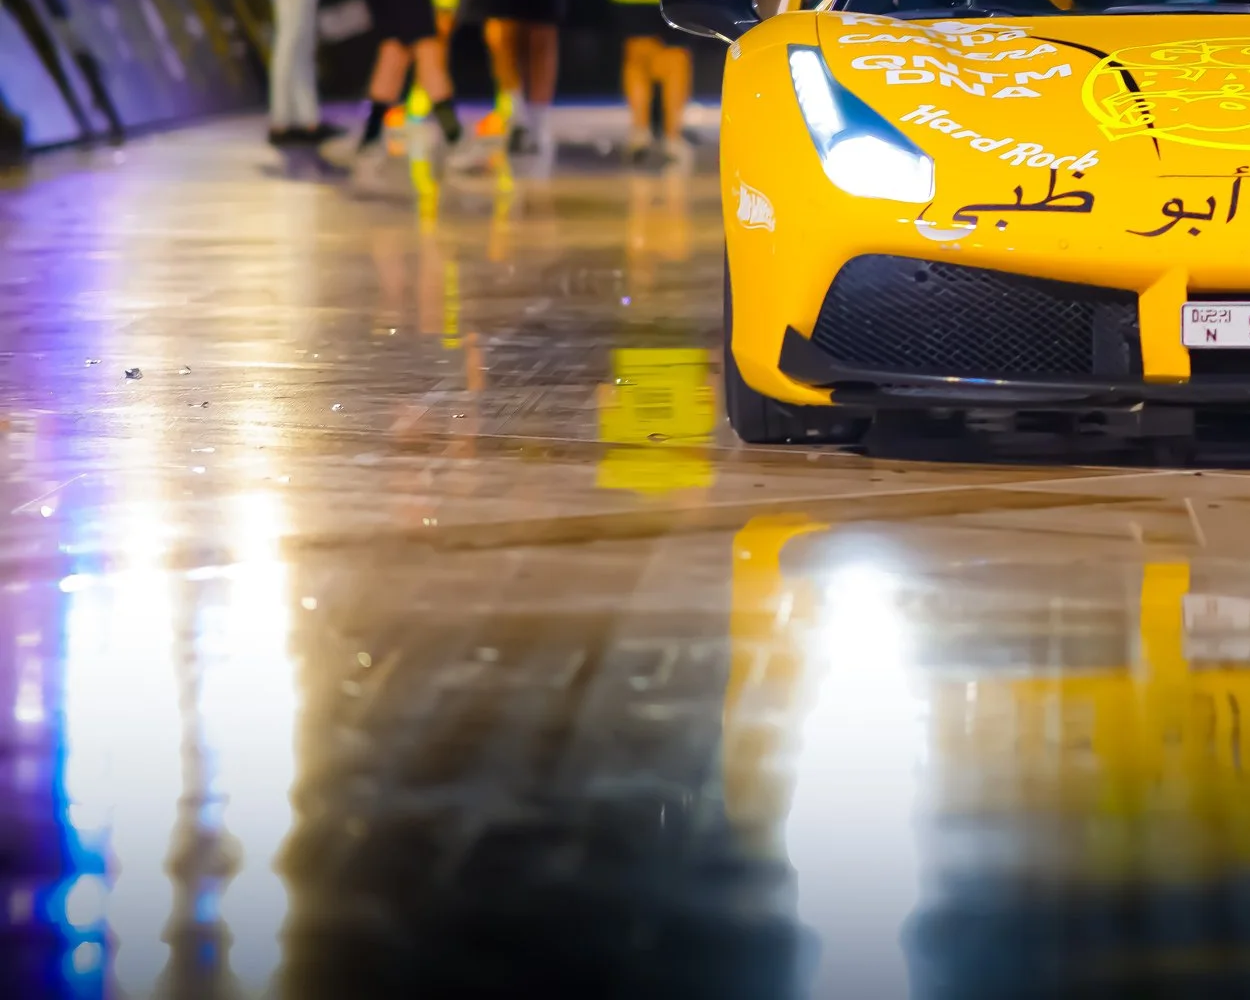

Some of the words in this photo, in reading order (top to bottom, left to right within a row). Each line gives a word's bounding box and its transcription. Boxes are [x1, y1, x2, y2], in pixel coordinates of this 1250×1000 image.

[850, 54, 1073, 85] QNTM
[885, 69, 1042, 99] DNA
[899, 104, 1015, 153] Hard
[1125, 165, 1250, 237] أبو
[1206, 328, 1217, 342] N
